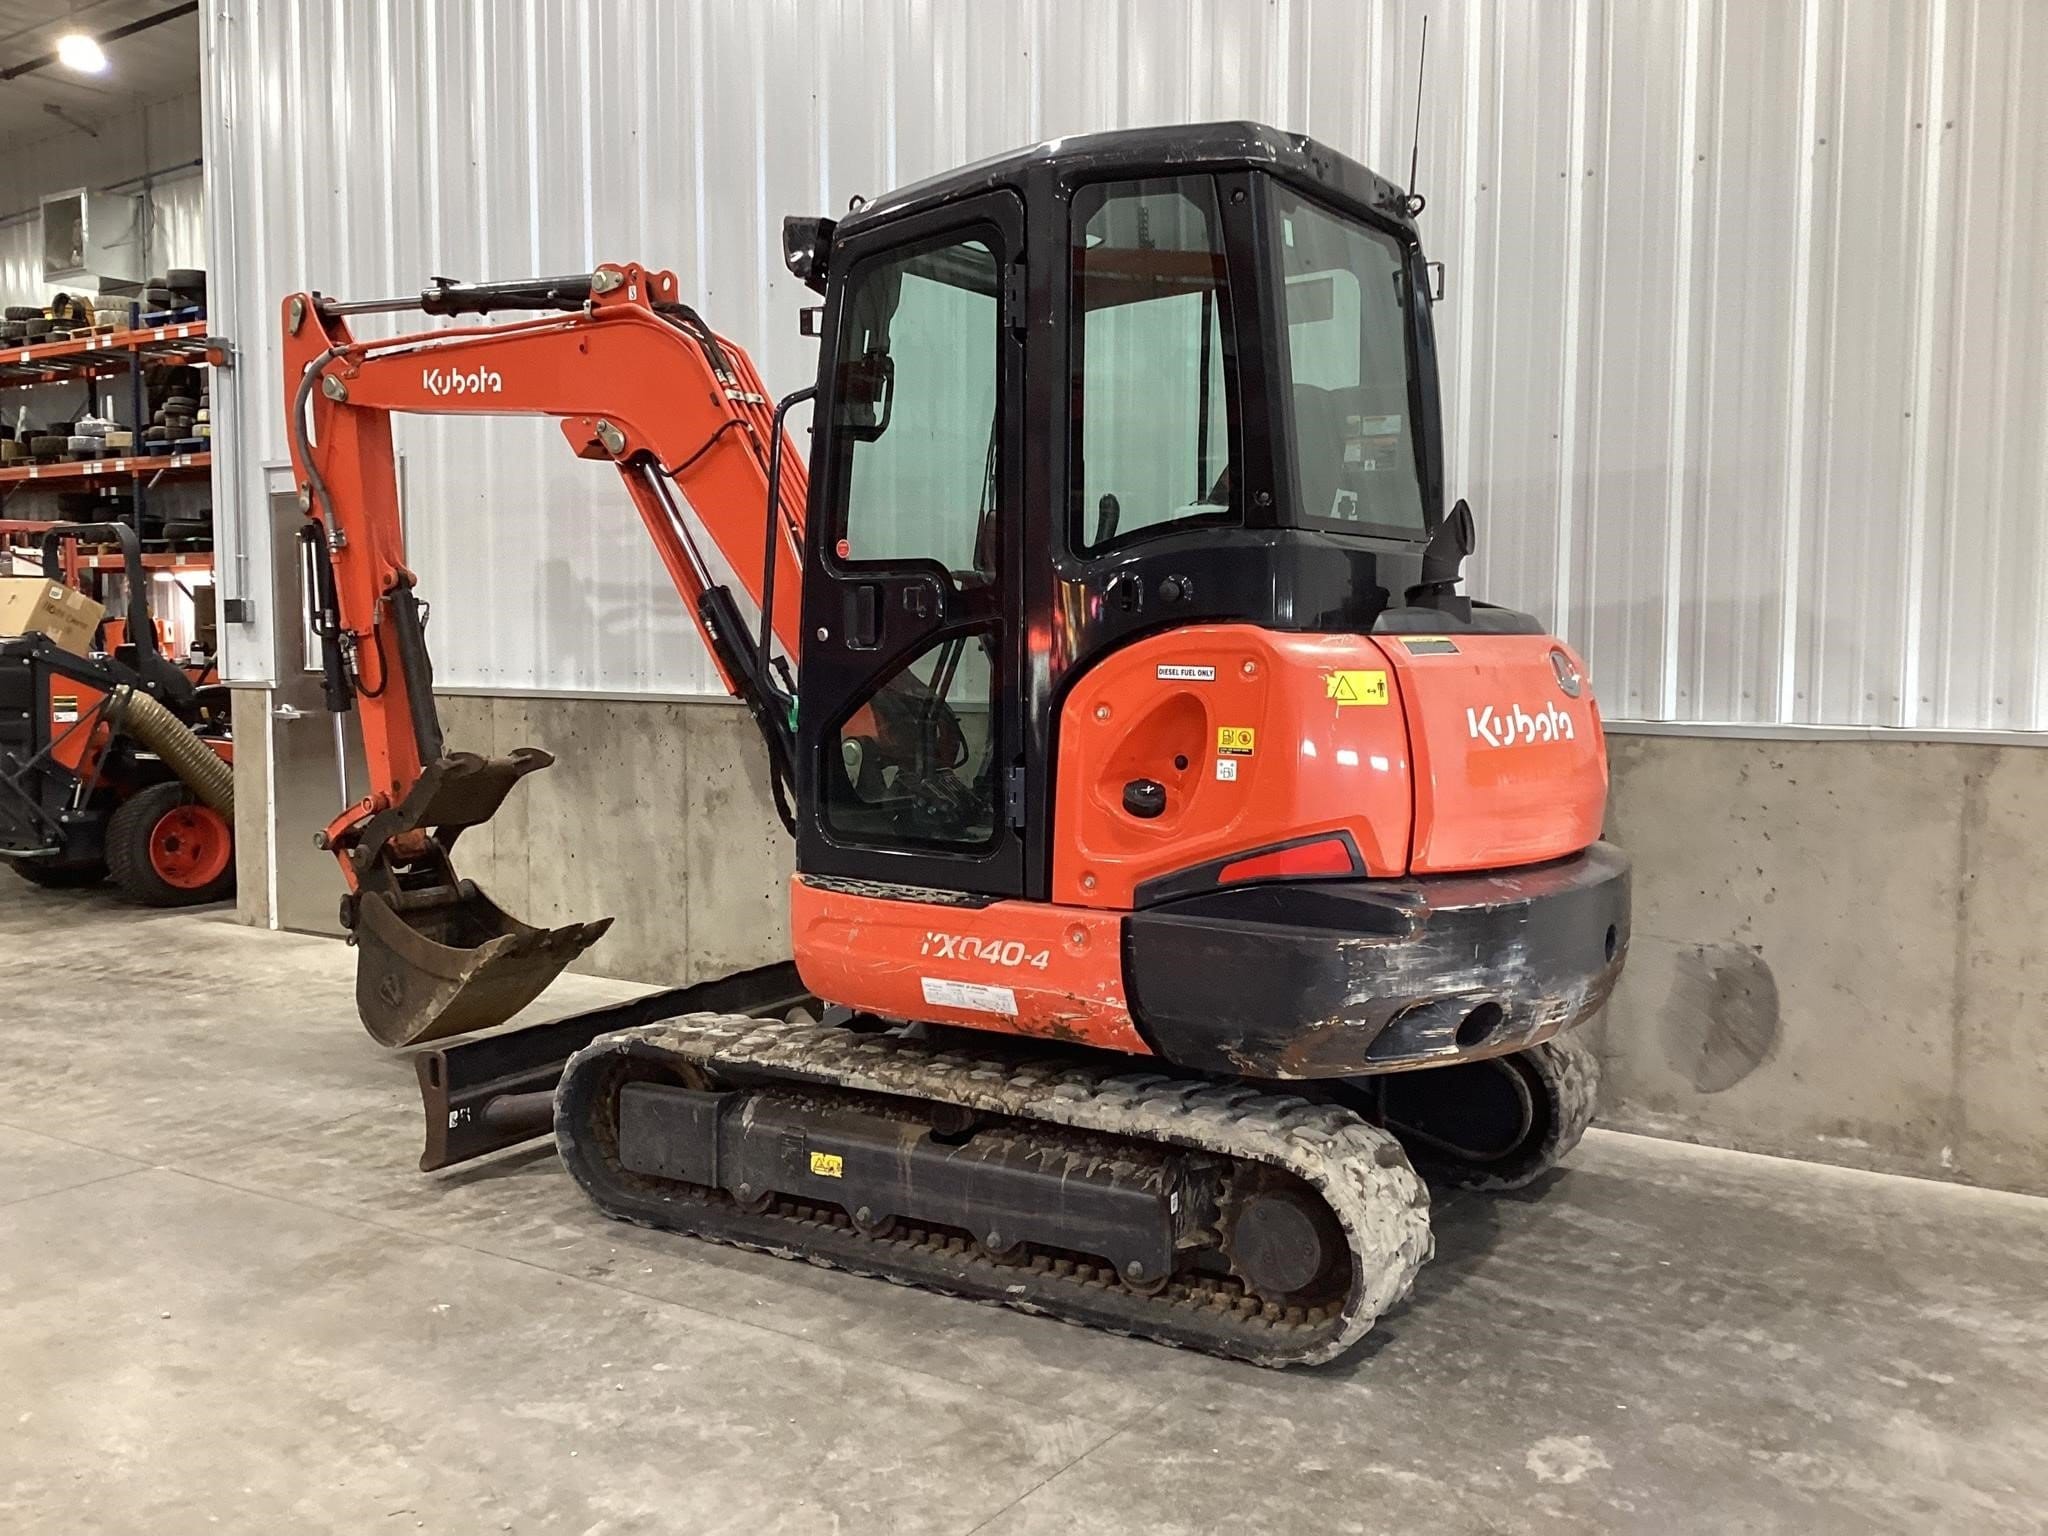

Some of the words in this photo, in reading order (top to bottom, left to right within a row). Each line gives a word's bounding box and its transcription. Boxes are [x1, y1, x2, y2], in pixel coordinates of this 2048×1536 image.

[423, 365, 502, 396] Kubota
[1158, 668, 1180, 676] DIESEL
[1181, 668, 1196, 677] FUEL
[1197, 669, 1214, 677] ONLY
[1466, 700, 1575, 747] Kubota
